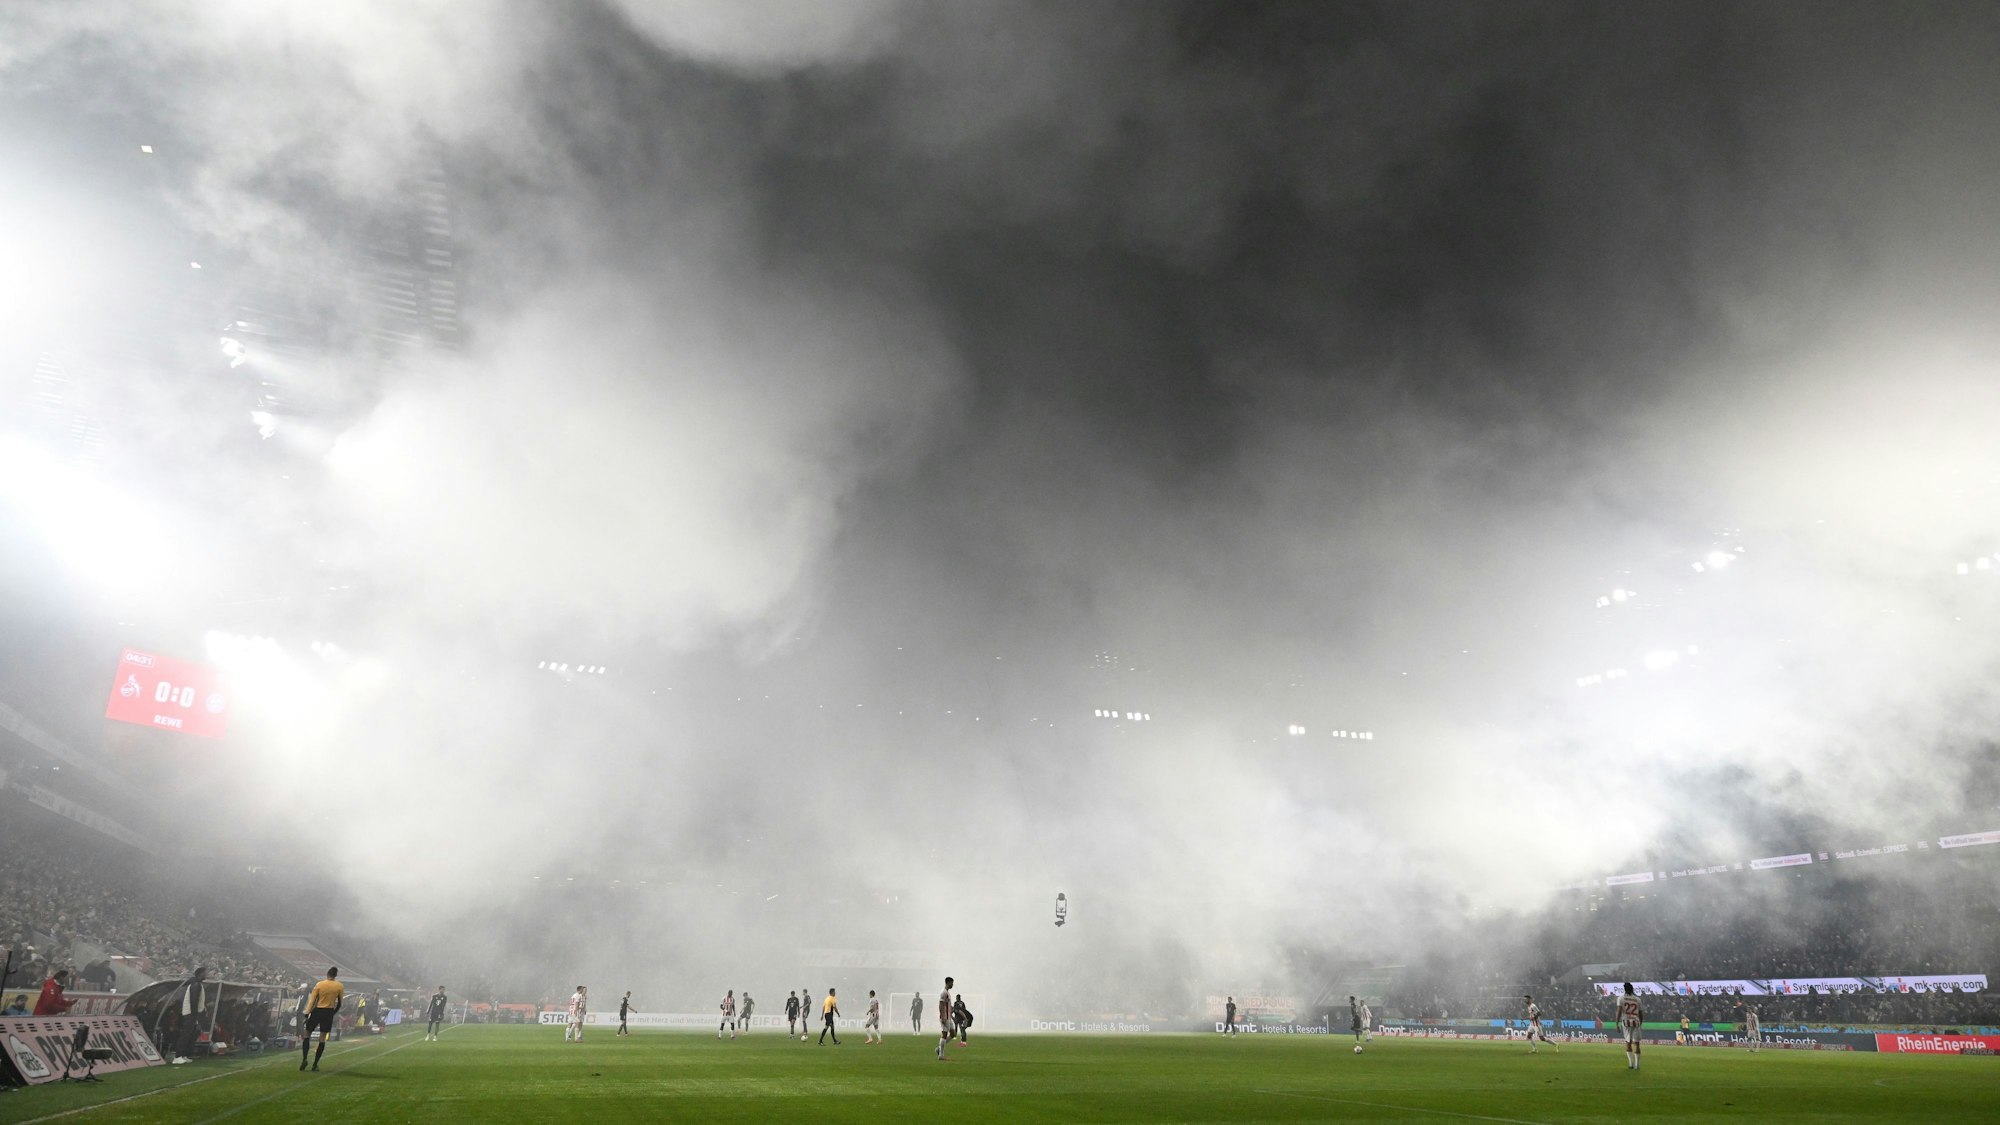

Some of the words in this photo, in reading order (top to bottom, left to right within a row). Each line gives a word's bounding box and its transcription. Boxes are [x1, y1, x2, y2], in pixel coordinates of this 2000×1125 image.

[155, 681, 195, 708] 0:0
[154, 715, 183, 728] REWE
[1793, 982, 1858, 994] Systmlösungen
[1624, 1002, 1638, 1015] 22
[543, 1014, 569, 1023] STRE
[1031, 1019, 1075, 1031] Dorint
[1081, 1022, 1107, 1032] Hotels
[1110, 1022, 1116, 1031] &
[1119, 1022, 1150, 1032] Resorts
[1262, 1024, 1286, 1034] Hotels
[1289, 1025, 1294, 1034] &
[1296, 1025, 1327, 1034] Resorts
[1897, 1036, 1987, 1052] RheinEnergie
